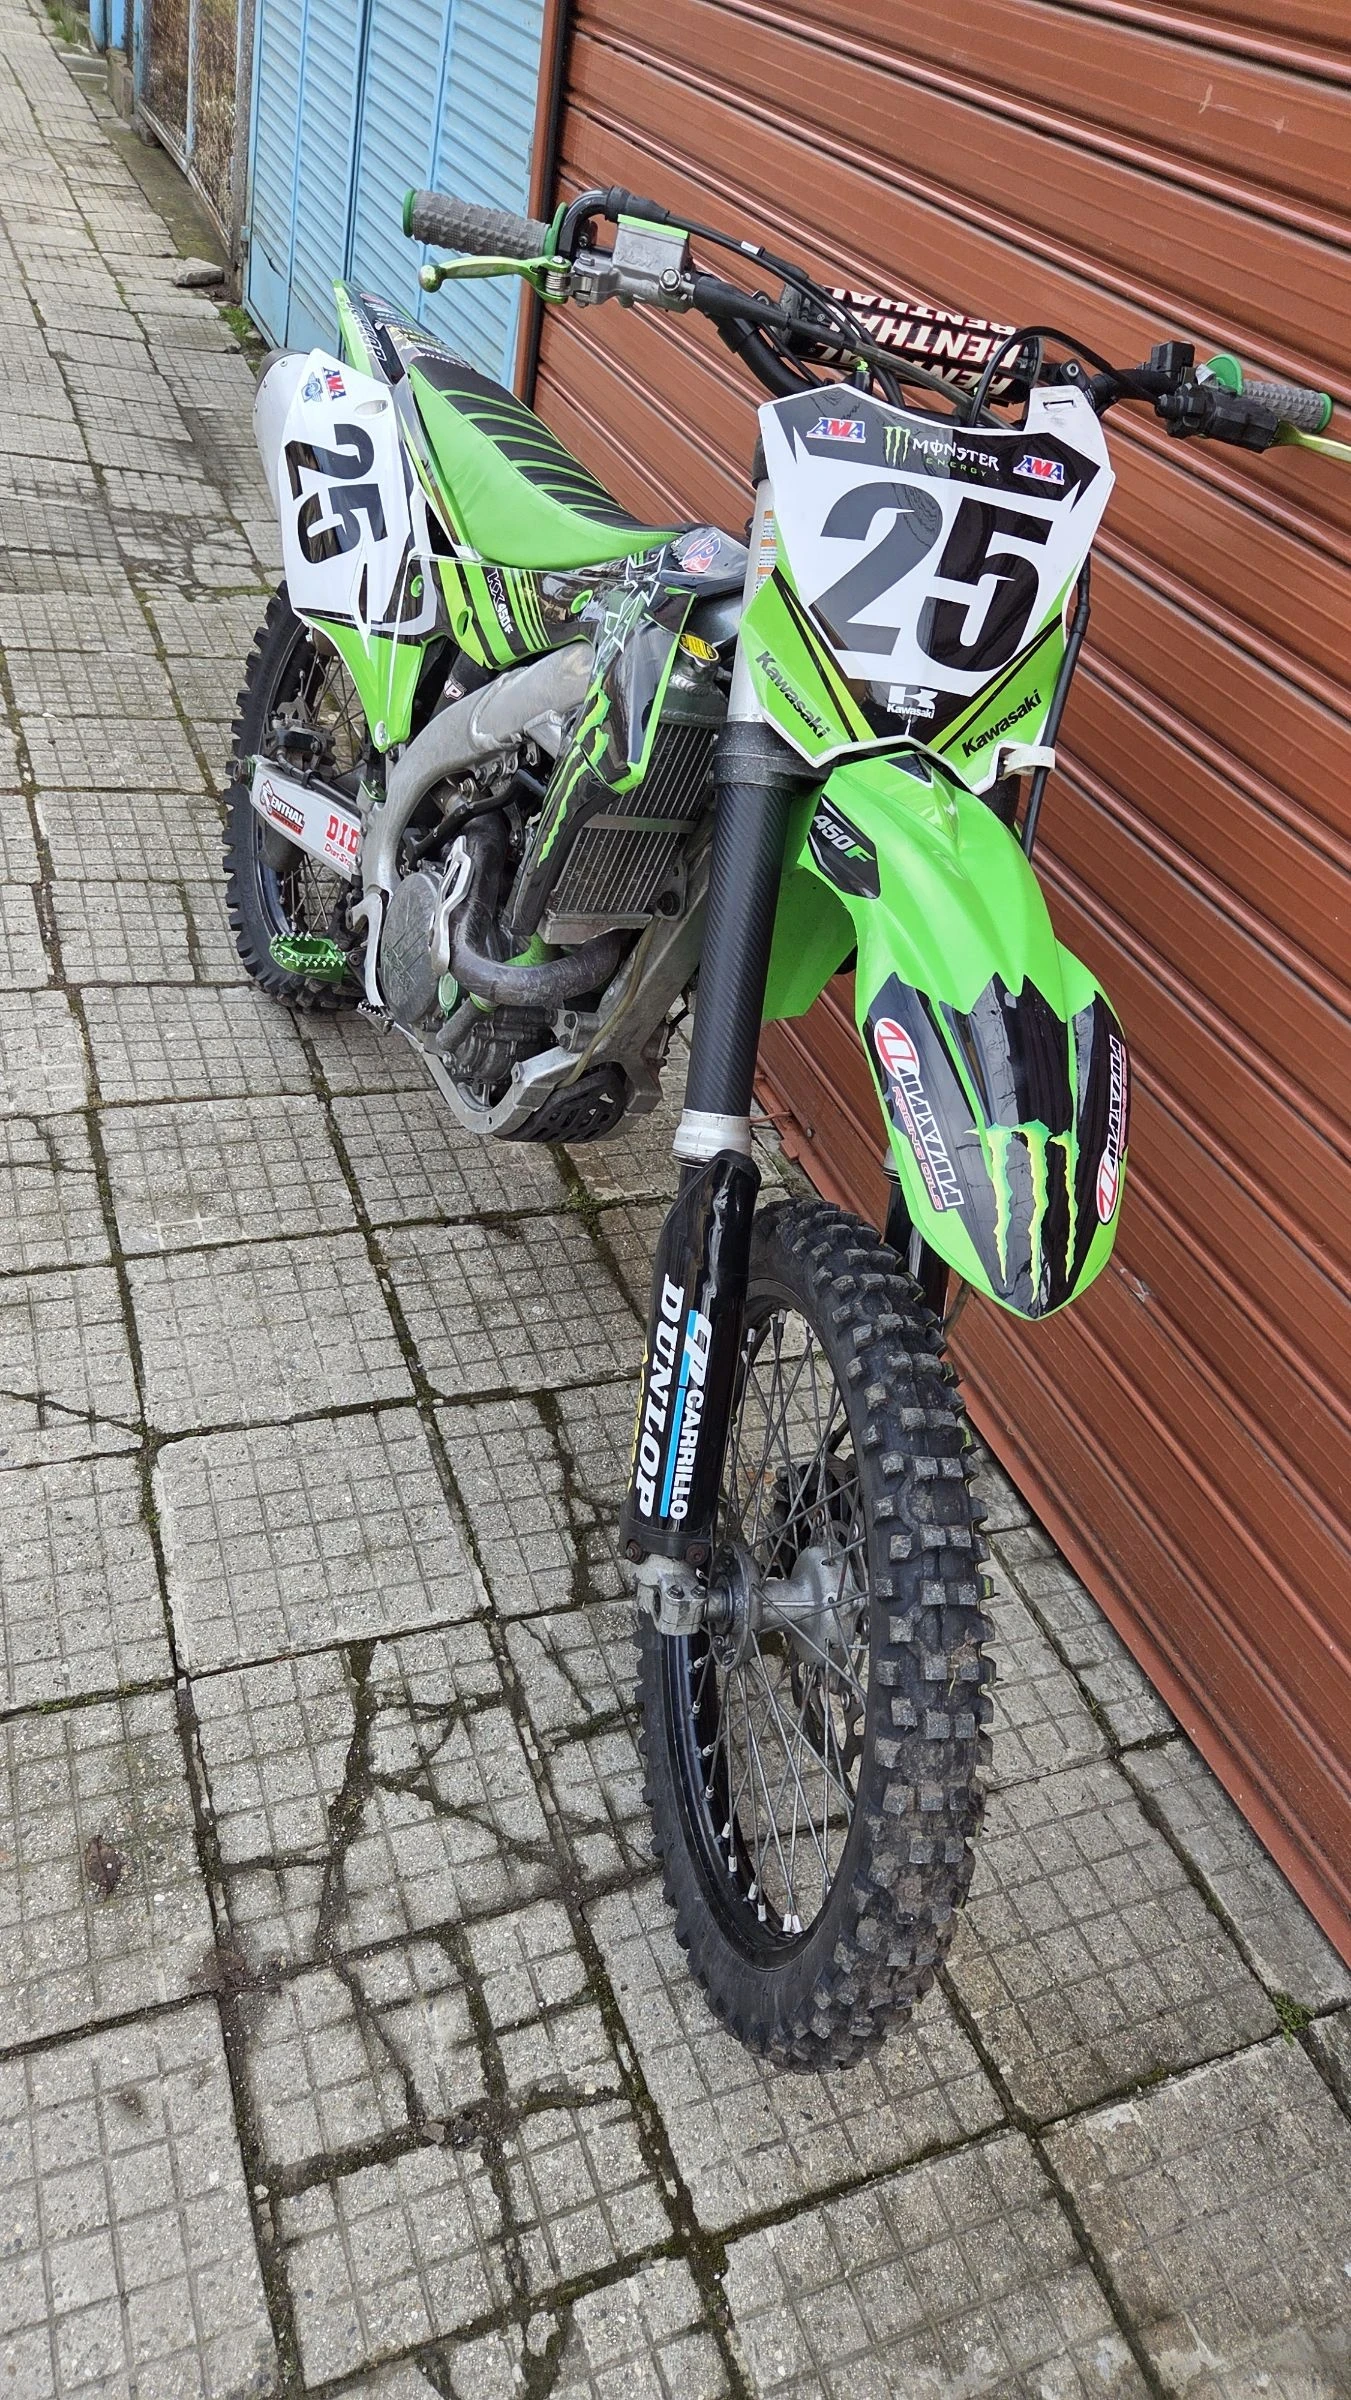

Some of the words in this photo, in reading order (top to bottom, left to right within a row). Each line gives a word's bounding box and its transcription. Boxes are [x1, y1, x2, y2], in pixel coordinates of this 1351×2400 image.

[322, 366, 347, 401] AMA
[807, 417, 866, 443] AMA
[911, 437, 1000, 472] MONSTER
[284, 423, 388, 565] 25
[925, 457, 988, 477] ENERGY
[1014, 455, 1064, 484] AMA
[808, 481, 1054, 673] 25
[755, 650, 831, 739] Kawasaki
[886, 703, 935, 720] Kawasaki
[961, 688, 1042, 758] Kawasaki
[813, 814, 876, 863] 450F
[683, 1312, 713, 1390] CP
[635, 1272, 686, 1518] DUNLOP
[668, 1388, 705, 1521] CARRILLO
